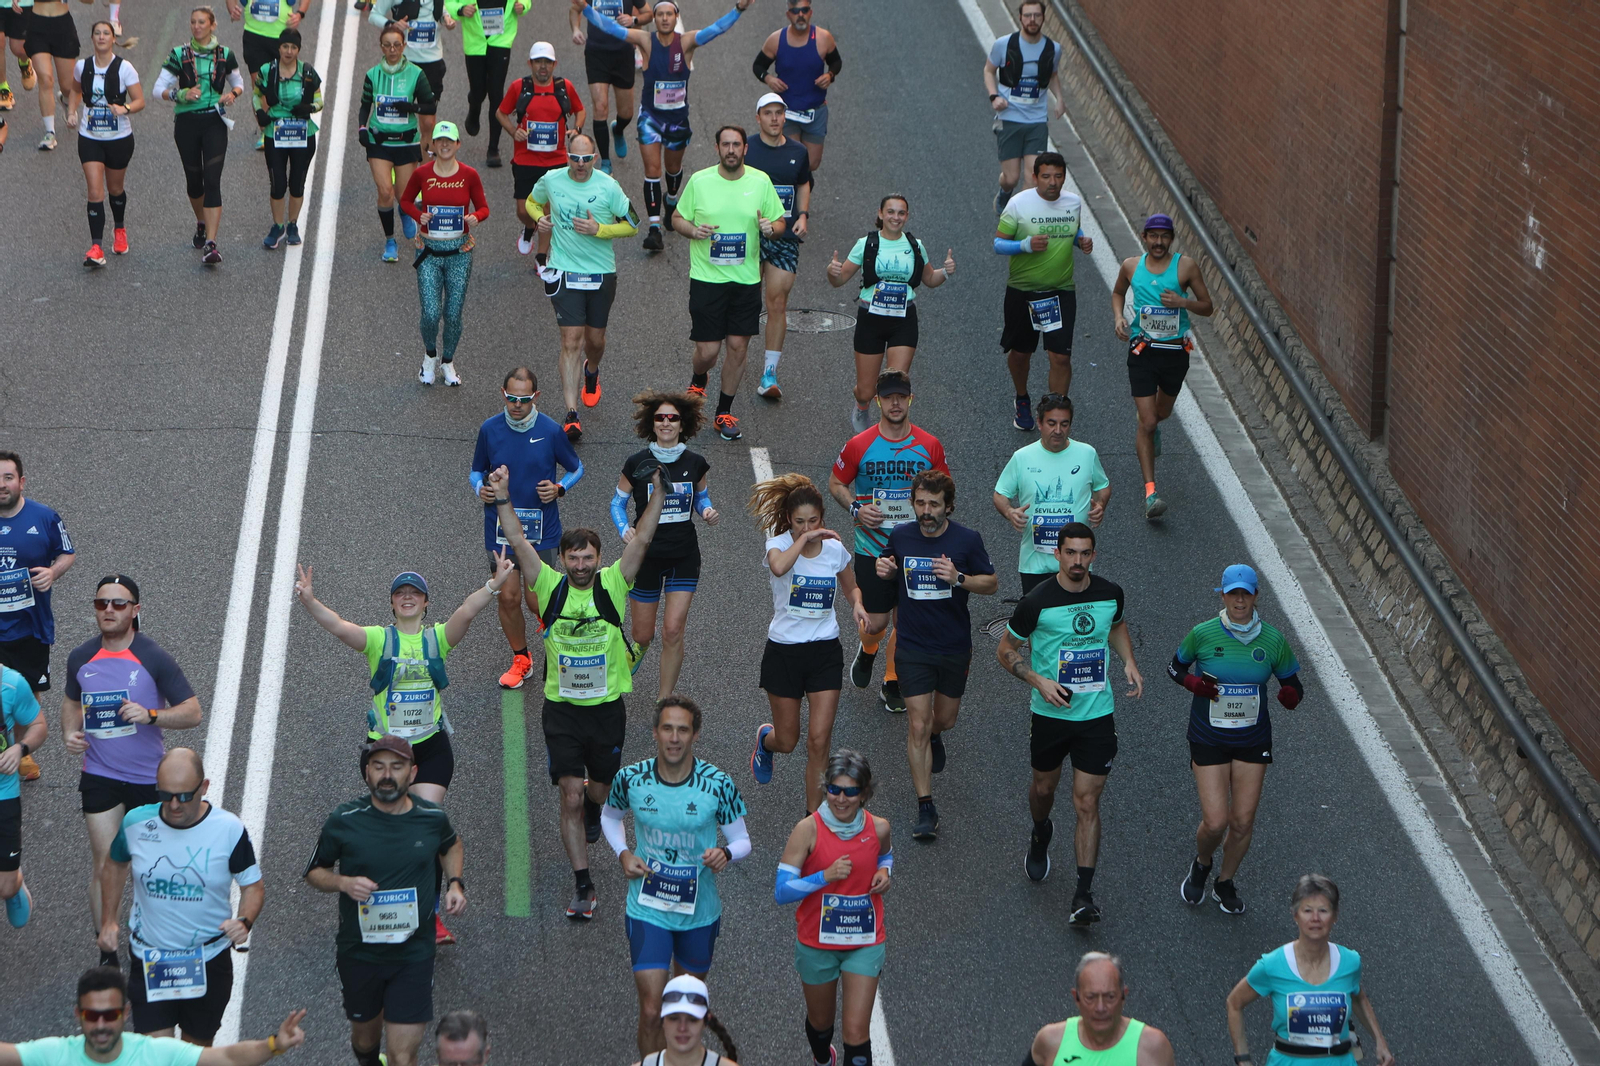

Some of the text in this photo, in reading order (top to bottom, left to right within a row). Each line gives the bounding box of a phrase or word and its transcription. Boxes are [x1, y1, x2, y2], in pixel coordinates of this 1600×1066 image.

[427, 178, 465, 190] Franci
[1030, 216, 1075, 224] C.D.RUNNING
[1039, 224, 1070, 234] sano
[1036, 300, 1055, 308] ZURICH
[865, 460, 925, 476] BROOKS
[1077, 652, 1100, 660] ZURICH
[574, 657, 600, 666] ZURICH
[95, 694, 123, 702] ZURICH
[405, 693, 431, 702] ZURICH
[664, 867, 691, 877] ZURICH
[378, 893, 409, 903] ZURICH
[843, 898, 869, 907] ZURICH
[164, 950, 196, 959] ZURICH
[1310, 996, 1341, 1004] ZURICH
